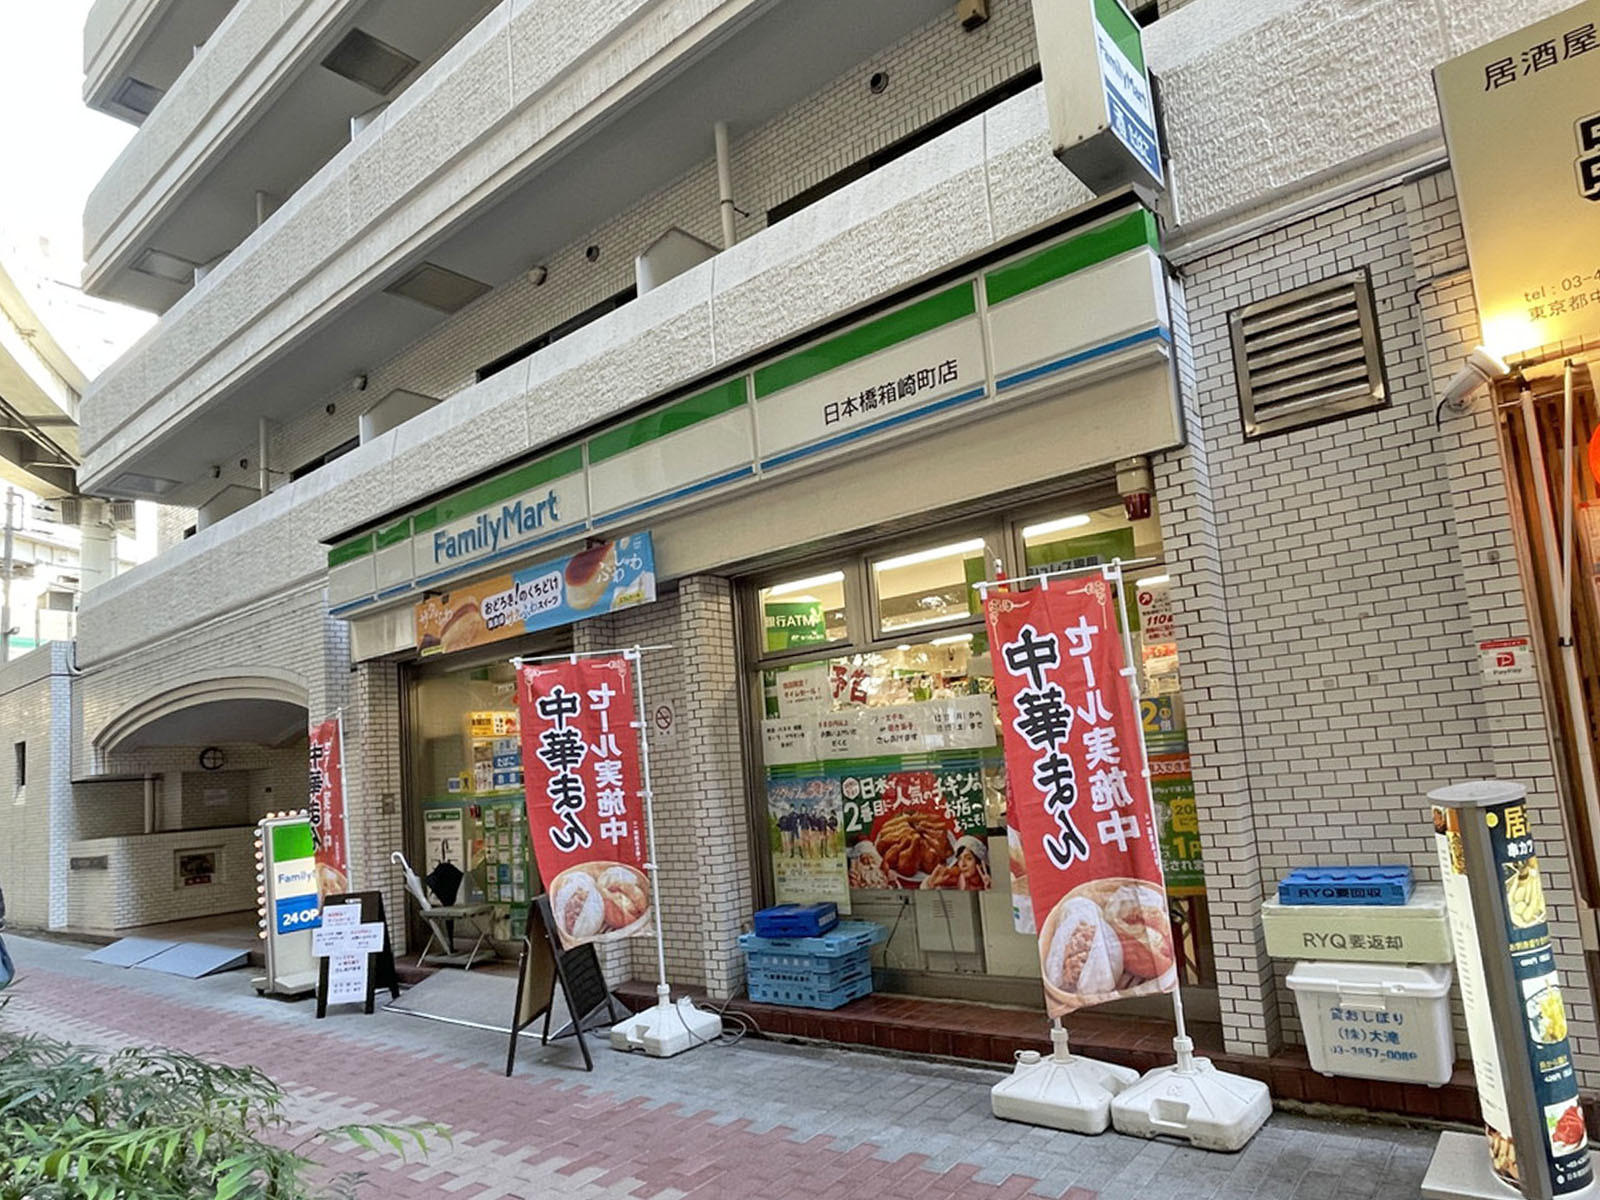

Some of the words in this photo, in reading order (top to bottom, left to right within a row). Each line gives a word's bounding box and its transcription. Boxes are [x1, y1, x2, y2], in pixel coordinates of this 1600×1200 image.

[1484, 23, 1600, 92] 居酒屋
[823, 358, 959, 426] 日本橋箱崎町店
[433, 490, 561, 563] FamilyMart
